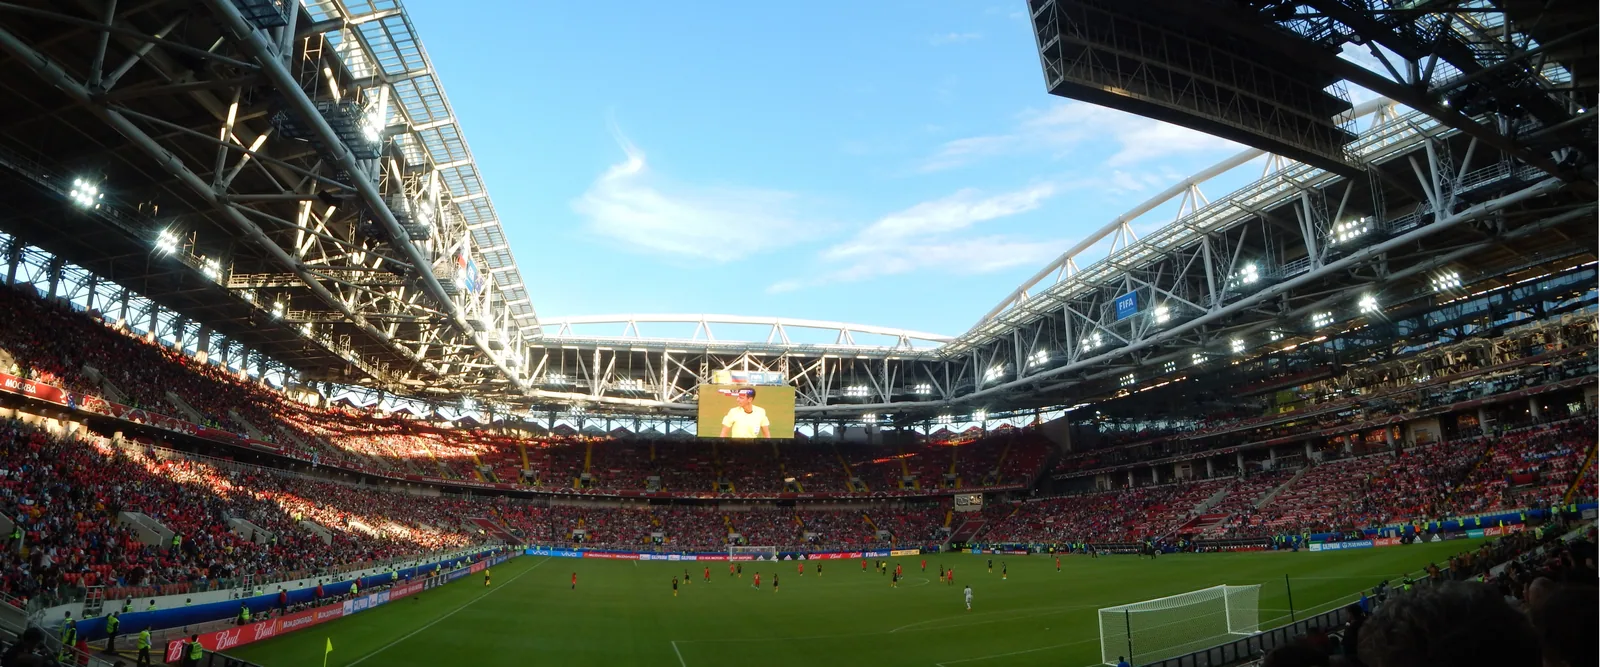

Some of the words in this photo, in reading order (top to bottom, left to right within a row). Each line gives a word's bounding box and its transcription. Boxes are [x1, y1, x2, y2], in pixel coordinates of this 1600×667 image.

[1118, 297, 1134, 311] FIFA
[5, 378, 36, 393] МОСКВА
[254, 618, 277, 641] Bud
[216, 629, 241, 651] Bud
